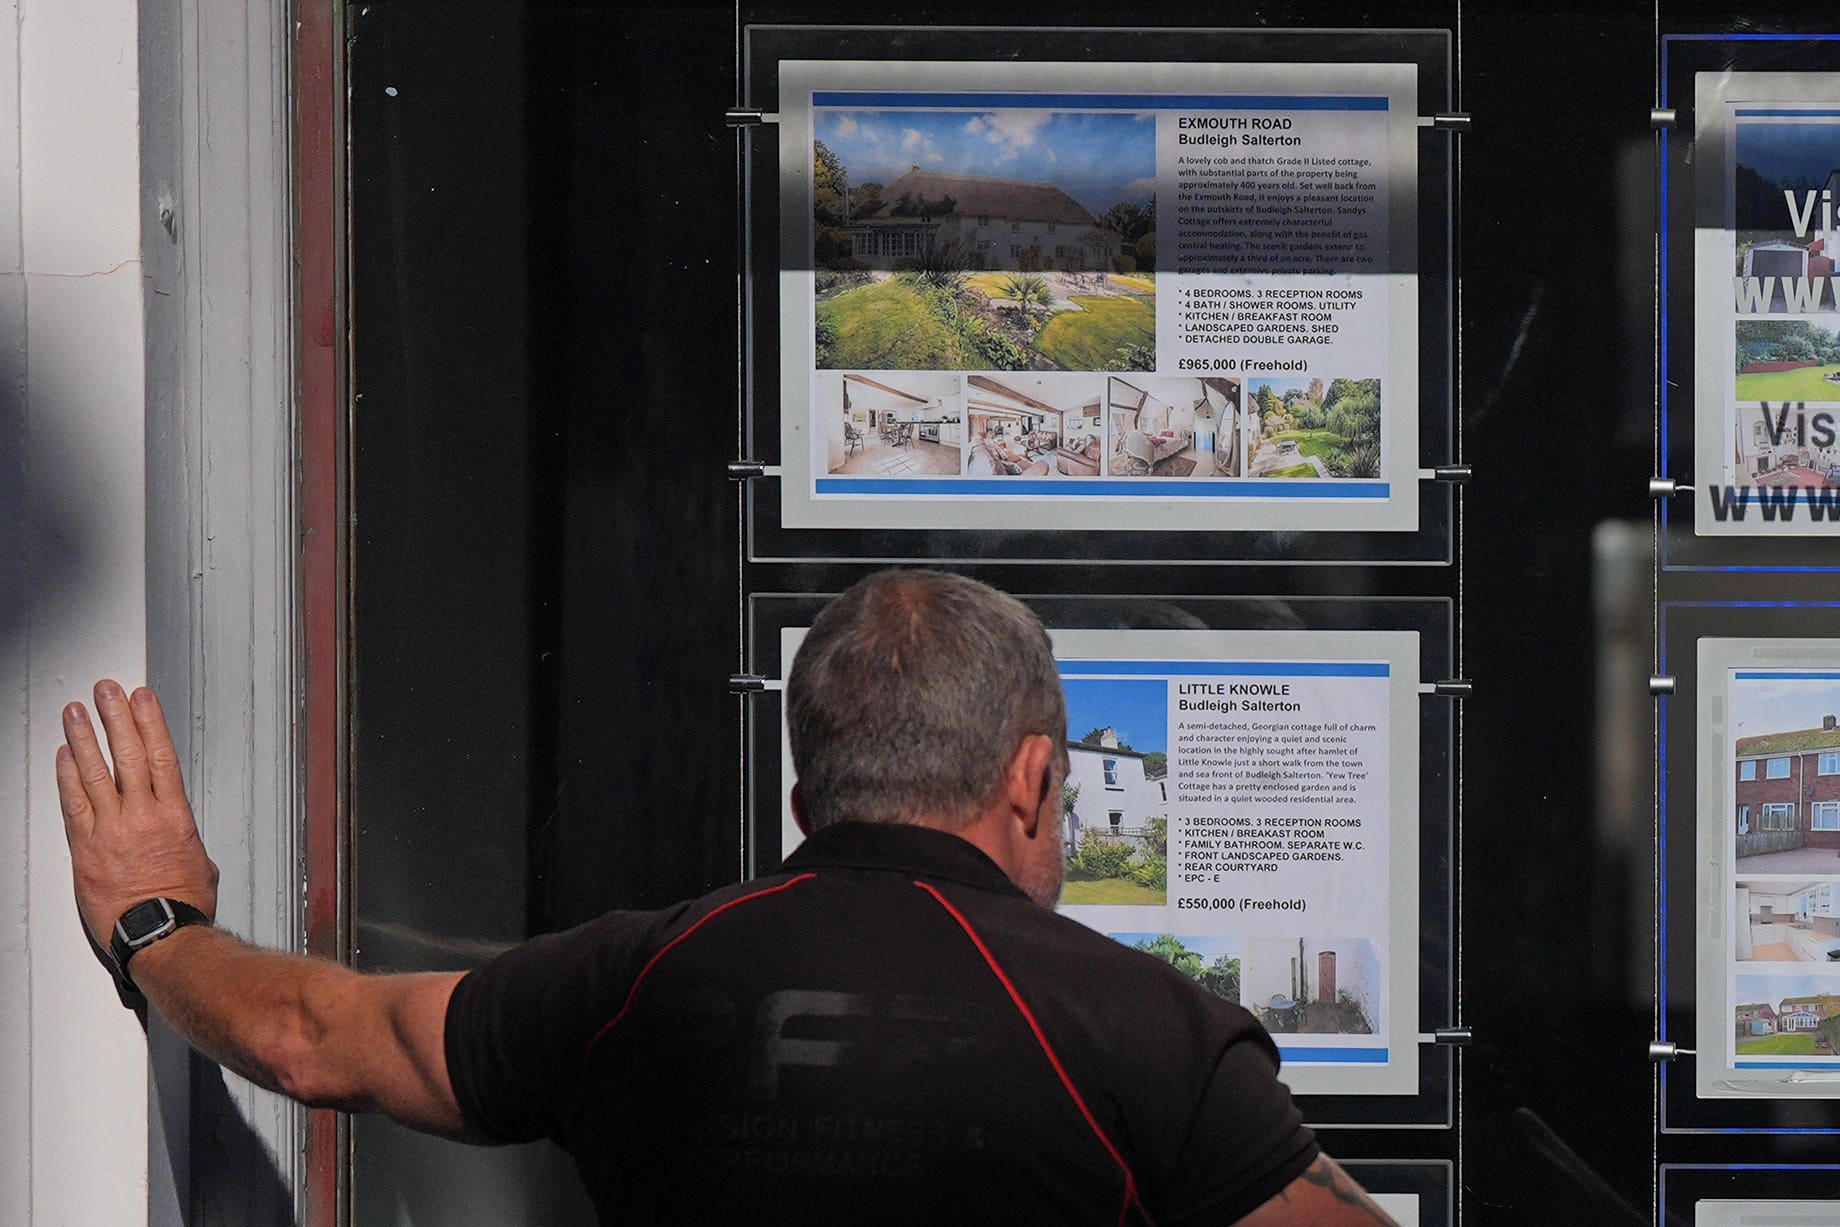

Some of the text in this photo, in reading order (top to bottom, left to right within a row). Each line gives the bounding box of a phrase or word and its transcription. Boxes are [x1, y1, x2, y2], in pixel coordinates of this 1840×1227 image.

[1178, 117, 1292, 130] EXMOUTH ROAD
[1178, 133, 1301, 148] Budleigh Salterton
[1177, 156, 1185, 164] A
[1186, 156, 1212, 166] lovely
[1213, 156, 1229, 165] cob
[1230, 156, 1246, 165] and
[1247, 156, 1275, 165] thatch
[1276, 157, 1302, 166] Grade
[1303, 157, 1310, 166] II
[1311, 157, 1336, 166] Listed
[1184, 289, 1191, 298] 4
[1257, 289, 1263, 299] 3
[1265, 289, 1323, 299] RECEPTION
[1325, 290, 1363, 300] ROOMS
[1184, 323, 1254, 333] LANDSCAPED
[1311, 324, 1339, 334] SHED
[1184, 334, 1241, 344] DETACHED
[1242, 334, 1284, 344] DOUBLE
[1178, 358, 1308, 372] £965,000 (Freehold)
[1179, 683, 1290, 696] LITTLE KNOWLE
[1179, 699, 1301, 714] Budleigh Salterton
[1185, 817, 1191, 826] 3
[1256, 817, 1262, 827] 3
[1264, 817, 1322, 828] RECEPTION
[1324, 818, 1362, 828] ROOMS
[1184, 839, 1222, 849] FAMILY
[1287, 840, 1340, 850] SEPARATE
[1184, 851, 1219, 861] FRONT
[1221, 851, 1290, 861] LANDSCAPED
[1184, 862, 1278, 872] REAR COURTYARD
[1177, 897, 1306, 912] £550,000 (Freehold)
